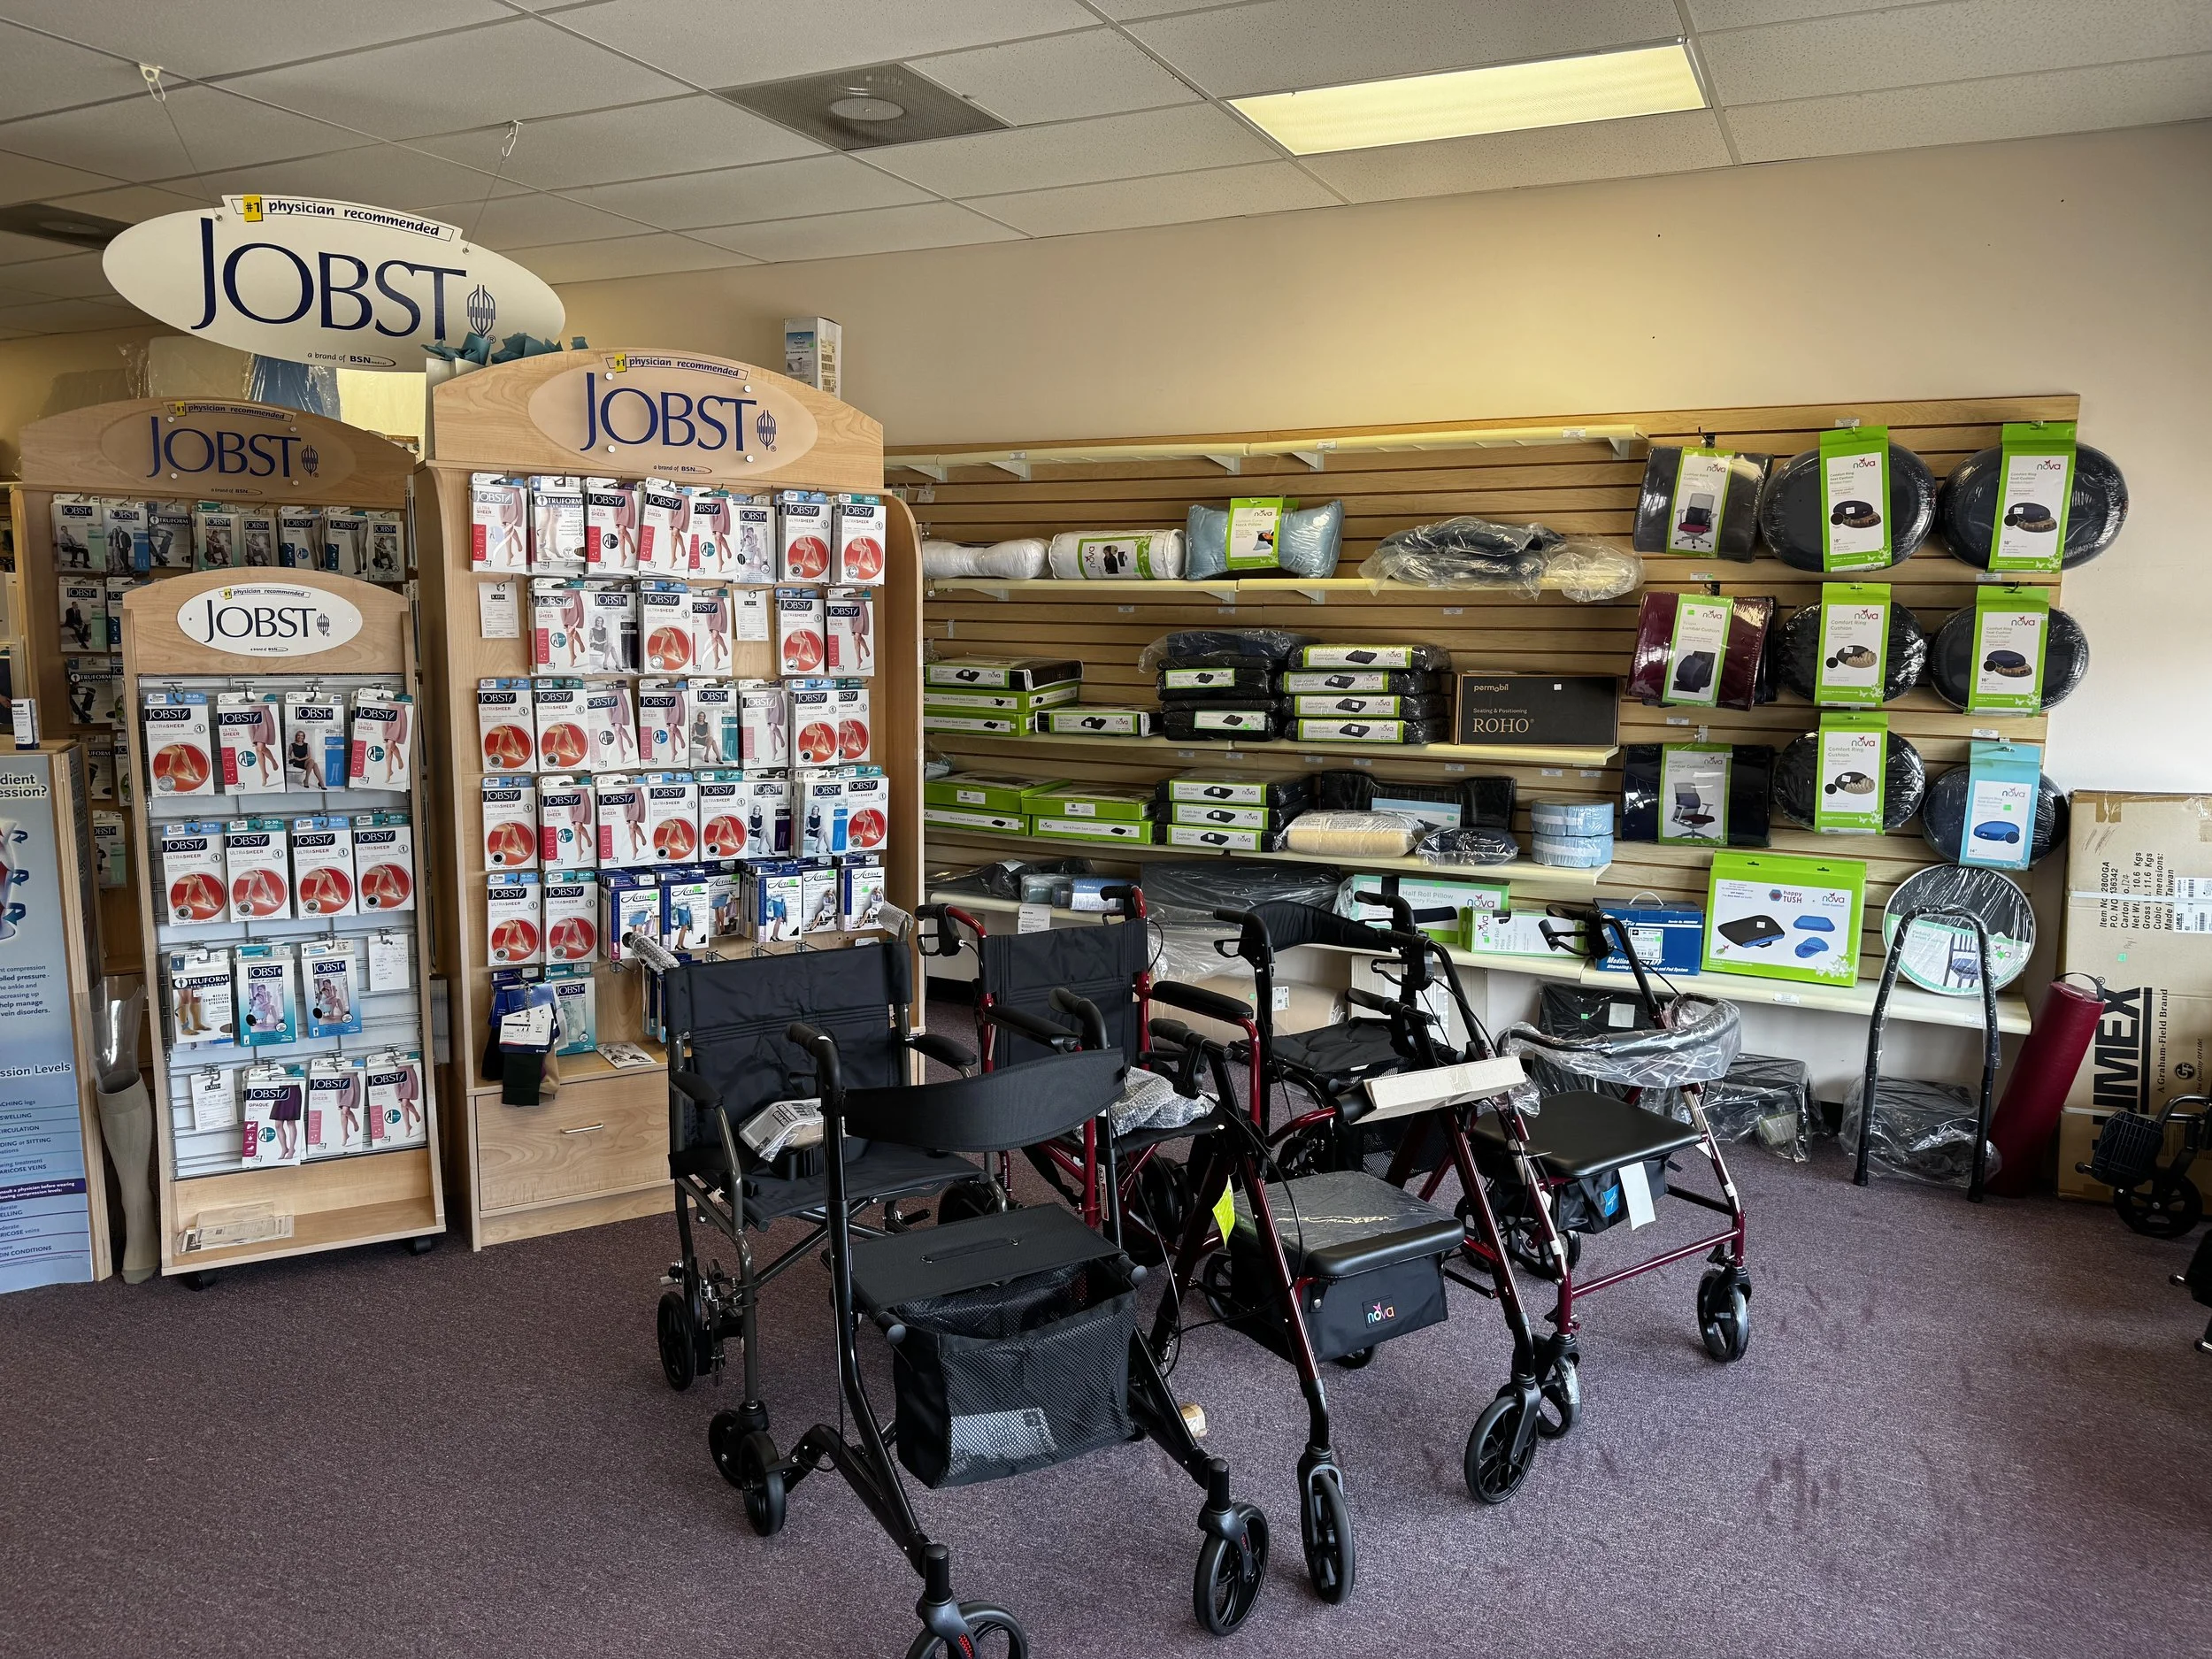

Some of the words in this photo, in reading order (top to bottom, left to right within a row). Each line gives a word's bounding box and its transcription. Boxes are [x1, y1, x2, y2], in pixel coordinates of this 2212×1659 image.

[245, 202, 260, 213] #1
[269, 201, 334, 215] physician
[344, 209, 439, 236] recommended
[191, 218, 467, 341] JOBST
[339, 354, 346, 363] of
[630, 357, 671, 366] physician
[677, 361, 738, 376] recommended
[231, 407, 285, 419] recommended
[580, 372, 757, 451] JOBST
[146, 416, 301, 480] JOBST
[2037, 462, 2061, 471] nova
[649, 494, 675, 507] JOBST
[843, 506, 870, 515] JOBST
[645, 595, 672, 604] JOBST
[782, 600, 807, 610] JOBST
[829, 606, 855, 616] JOBST
[1855, 611, 1878, 620] nova
[204, 600, 316, 643] JOBST
[1474, 684, 1509, 693] permobil
[480, 694, 509, 703] JOBST
[538, 692, 566, 702] JOBST
[642, 696, 669, 706] JOBST
[798, 694, 821, 703] JOBST
[150, 709, 182, 720] JOBST
[296, 707, 327, 718] JOBST
[358, 708, 389, 718] JOBST
[221, 713, 254, 724] JOBST
[1473, 718, 1529, 733] ROHO
[1851, 738, 1875, 747] nova
[0, 774, 35, 785] dient
[486, 792, 514, 801] JOBST
[653, 788, 680, 797] JOBST
[2002, 789, 2025, 798] nova
[546, 796, 574, 806] JOBST
[602, 795, 629, 804] JOBST
[229, 836, 262, 847] JOBST
[296, 835, 328, 847] JOBST
[358, 832, 389, 843] JOBST
[166, 840, 200, 851] JOBST
[2134, 852, 2143, 867] Kgs
[2145, 853, 2154, 867] Kgs
[2165, 869, 2174, 896] Taiwan
[1467, 896, 1494, 908] nova
[1822, 895, 1845, 903] nova
[249, 967, 278, 978] JOBST
[313, 963, 341, 973] JOBST
[188, 976, 228, 985] TRUFORM
[2157, 1019, 2168, 1084] Graham-Field
[35, 1062, 70, 1073] Levels
[313, 1079, 342, 1089] JOBST
[372, 1074, 400, 1085] JOBST
[250, 1089, 281, 1100] JOBST
[11, 1246, 51, 1256] CONDITIONS
[1367, 1305, 1394, 1324] nova
